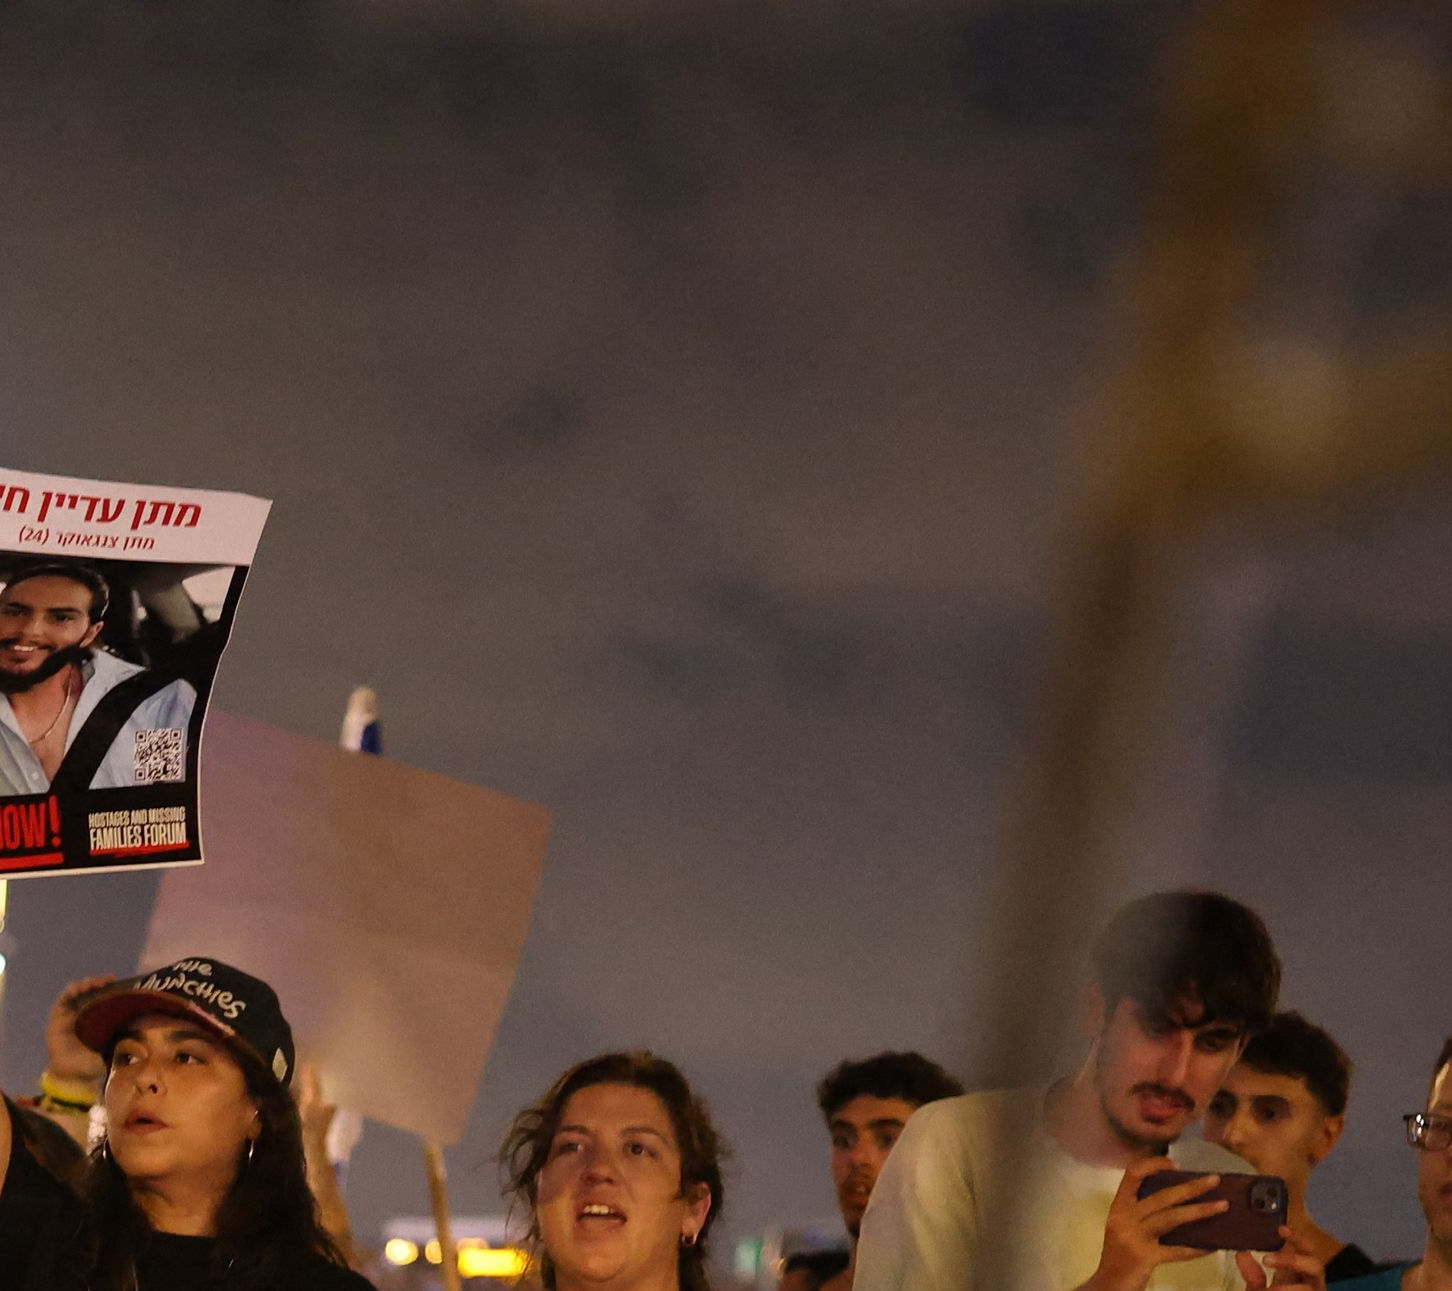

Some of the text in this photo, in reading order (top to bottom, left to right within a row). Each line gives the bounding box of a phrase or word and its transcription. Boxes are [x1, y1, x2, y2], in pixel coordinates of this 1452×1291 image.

[37, 491, 126, 523] עדיין
[130, 500, 202, 531] מתן
[18, 525, 155, 551] מתן צנגאוקר (24)
[88, 806, 186, 829] HOSTAGES AND MISSING
[89, 821, 187, 850] FAMILIES FORUM
